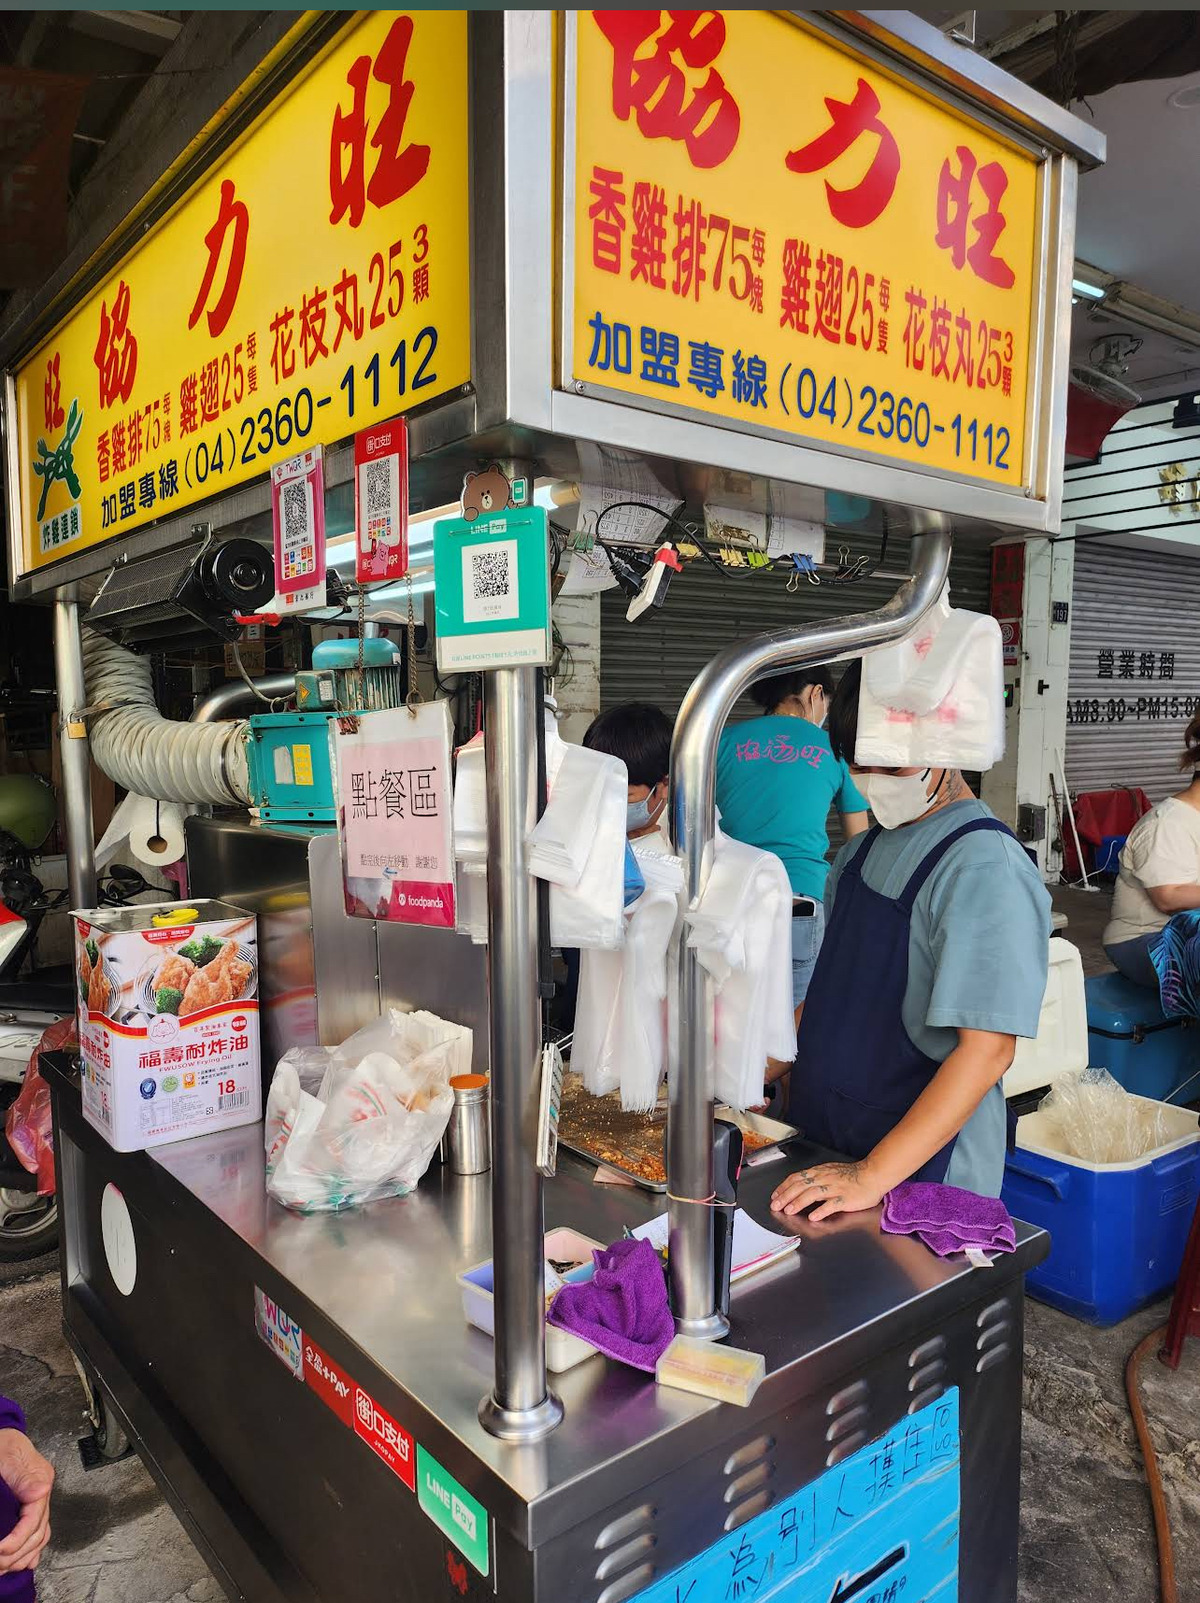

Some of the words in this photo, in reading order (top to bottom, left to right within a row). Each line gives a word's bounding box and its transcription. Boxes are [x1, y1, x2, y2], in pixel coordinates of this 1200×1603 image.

[779, 238, 875, 351] 雞翅25
[179, 342, 244, 439] 雞翅25
[1097, 649, 1175, 679] 營業時間
[351, 766, 439, 820] 點餐區
[408, 895, 444, 909] foodpanda
[139, 1034, 249, 1068] 福壽耐炸油
[218, 1079, 236, 1096] 18
[356, 1388, 409, 1463] 街口支付
[426, 1471, 451, 1510] LINE
[455, 1501, 473, 1531] Pay
